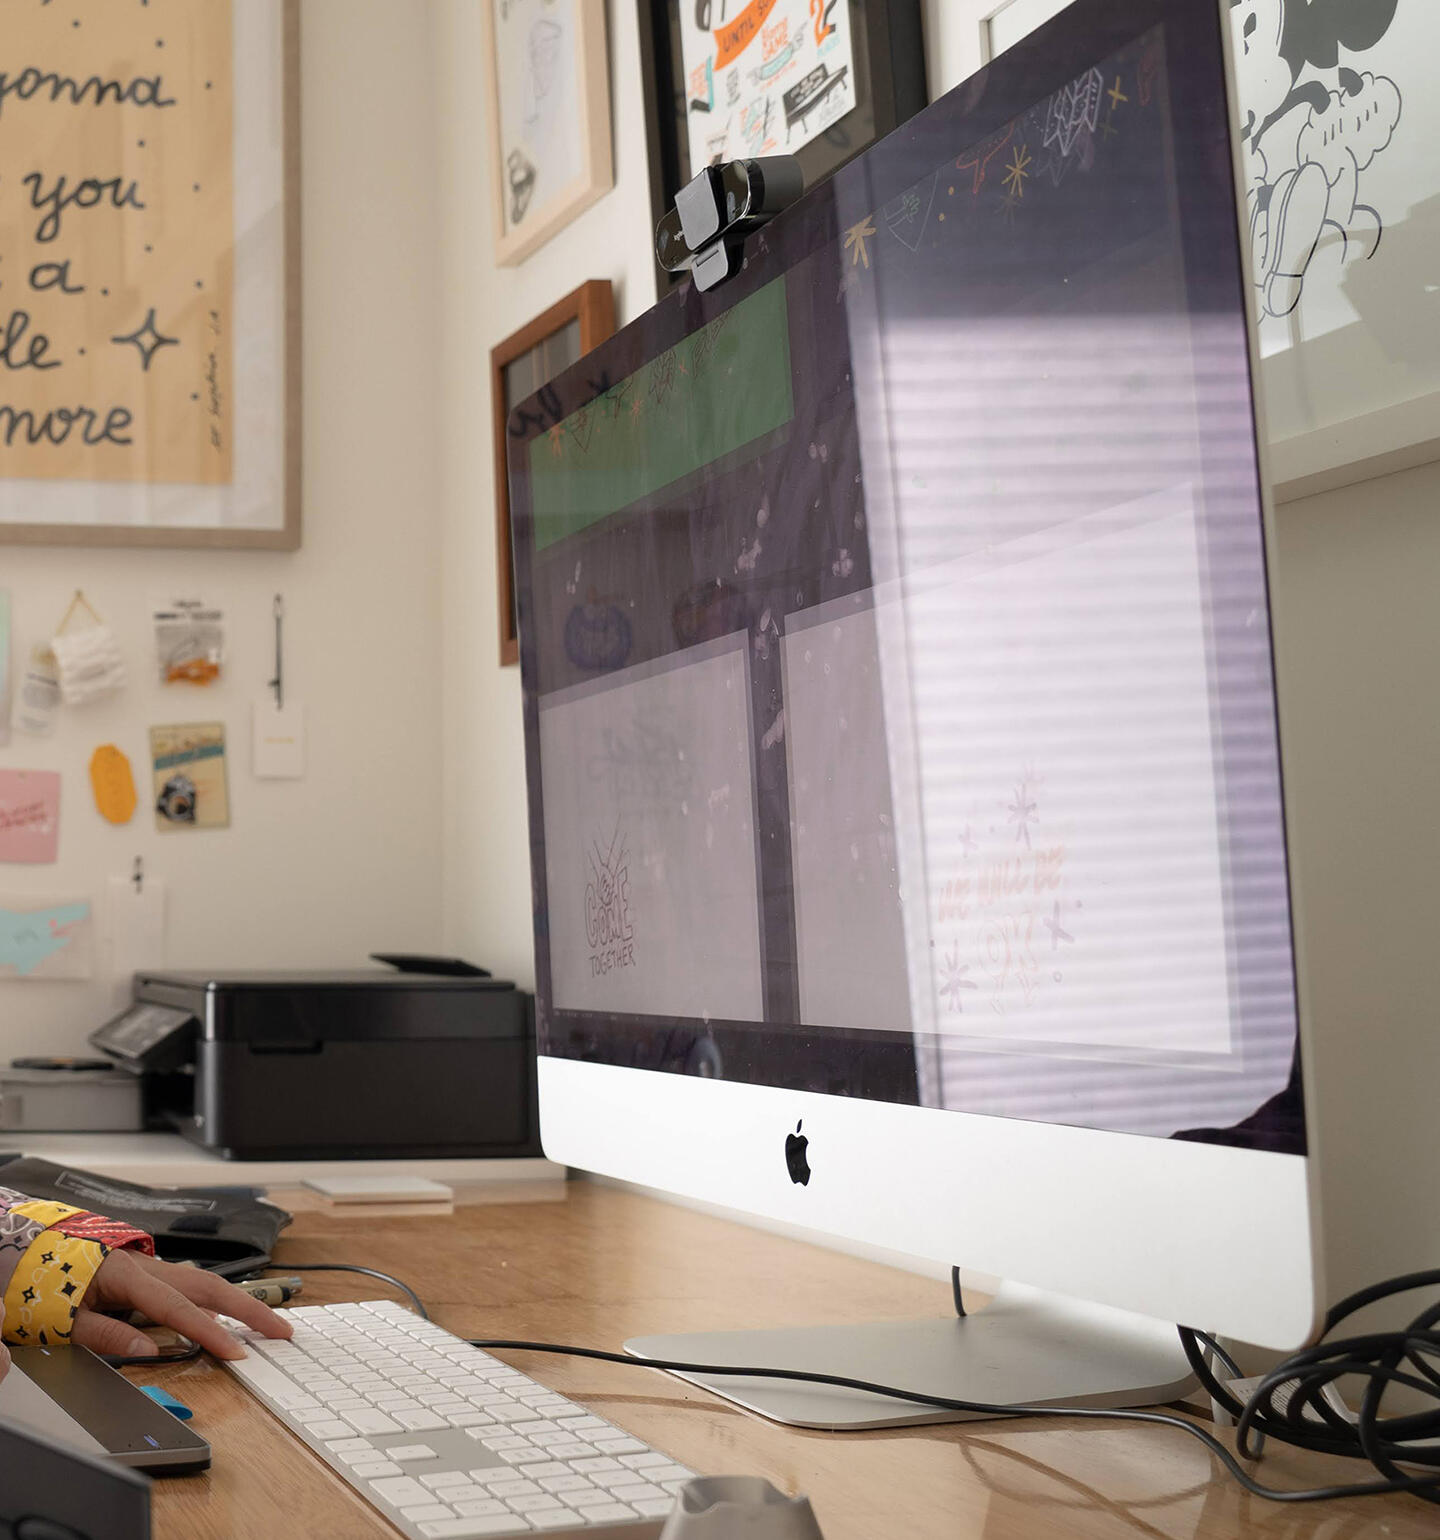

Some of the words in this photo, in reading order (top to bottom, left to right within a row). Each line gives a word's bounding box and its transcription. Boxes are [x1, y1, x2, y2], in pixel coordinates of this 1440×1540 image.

[722, 15, 755, 53] UNTIL
[21, 170, 146, 245] you
[28, 259, 86, 295] a
[589, 943, 637, 979] TOGETHER
